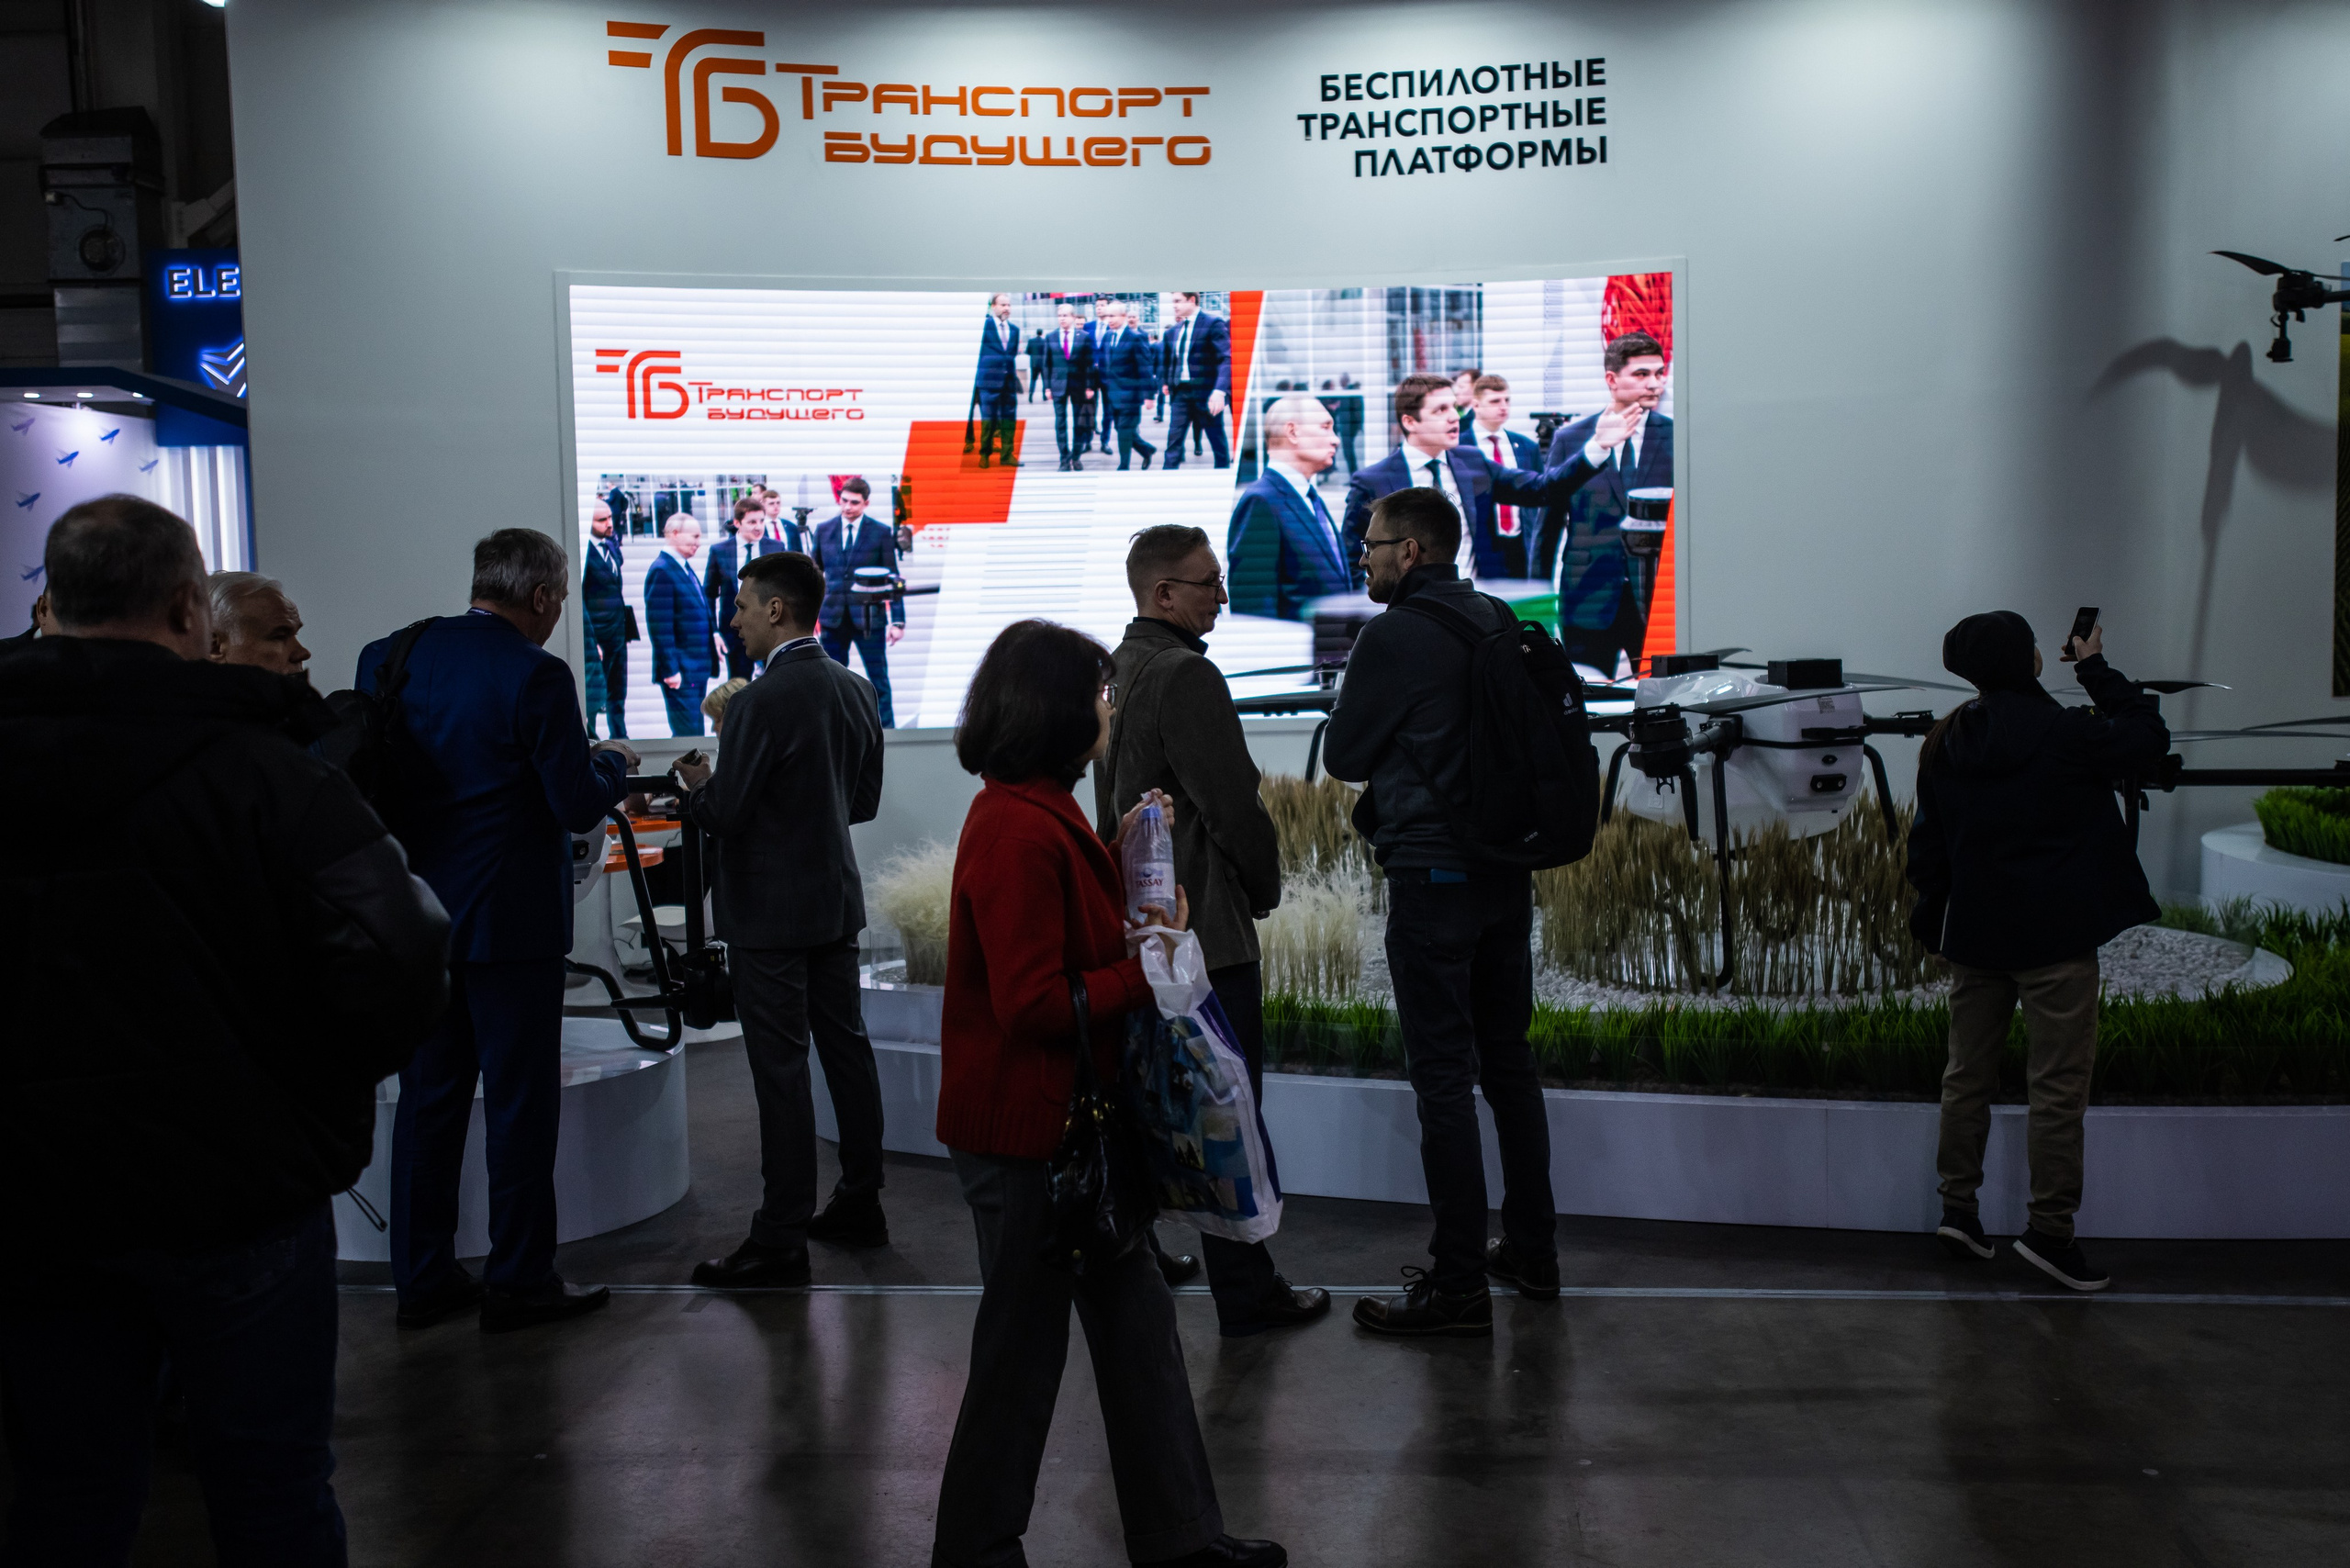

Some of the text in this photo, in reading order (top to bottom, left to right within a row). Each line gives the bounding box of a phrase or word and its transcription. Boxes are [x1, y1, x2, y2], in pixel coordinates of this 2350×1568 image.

[1320, 57, 1606, 102] БЕСПИЛОТНЫЕ
[1297, 96, 1606, 140] ТРАНСПОРТНЫЕ
[1354, 135, 1608, 178] ПЛАТФОРМЫ
